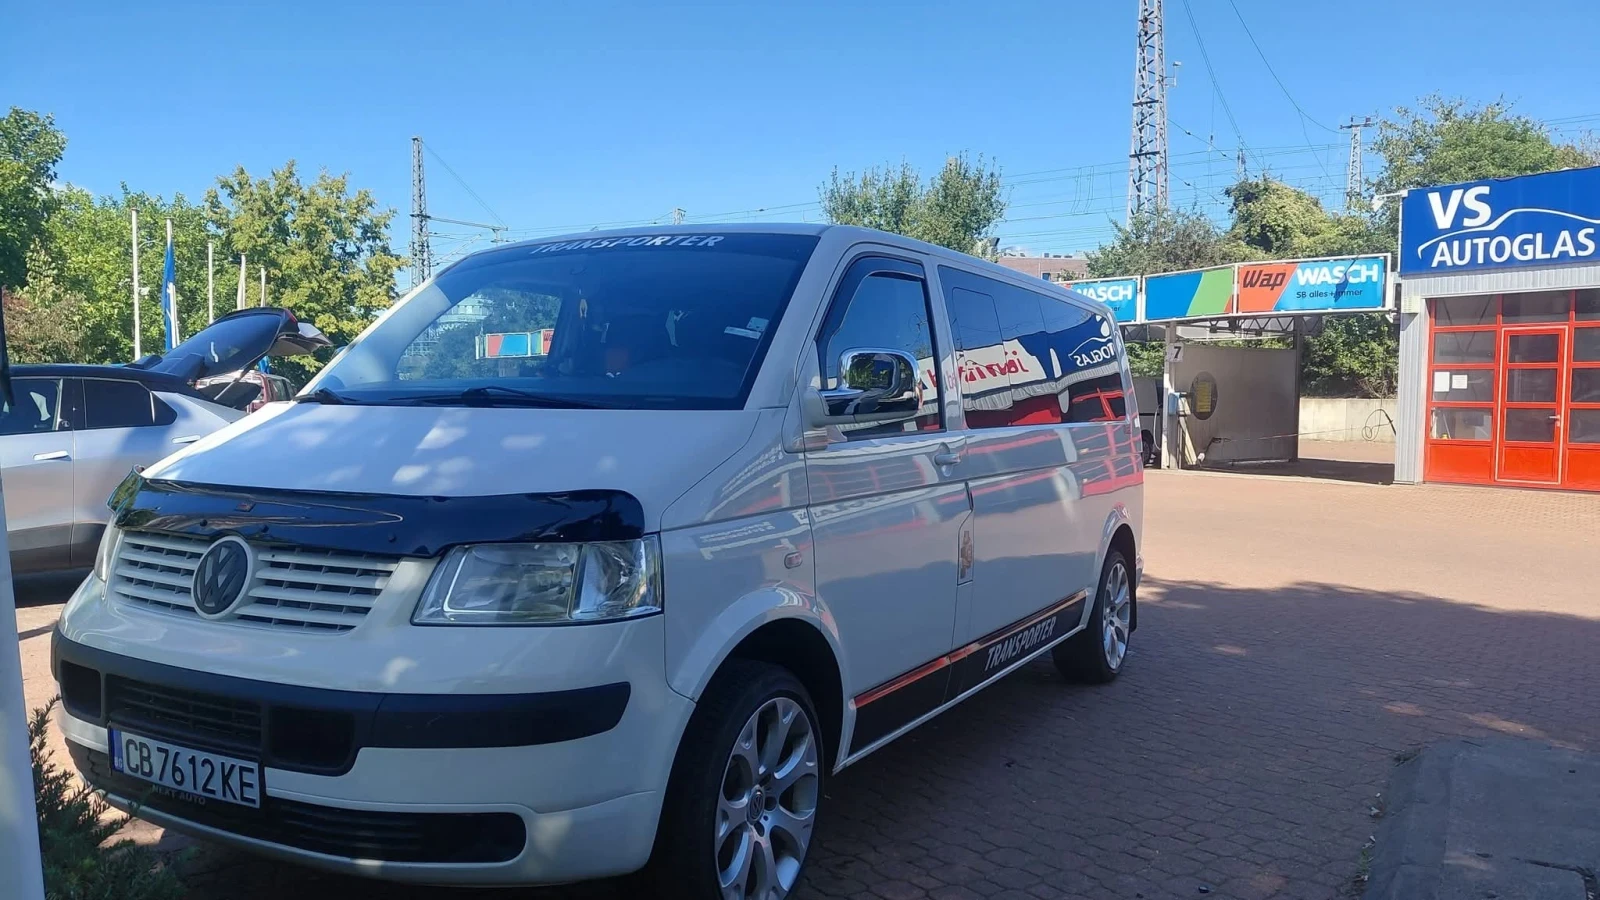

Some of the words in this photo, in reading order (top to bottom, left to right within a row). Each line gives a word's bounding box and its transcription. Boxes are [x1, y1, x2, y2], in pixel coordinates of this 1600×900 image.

[1427, 185, 1492, 230] VS
[530, 235, 725, 255] TRANSPORTER
[1431, 227, 1596, 268] AUTOGLAS
[1242, 268, 1287, 291] Wap
[1296, 263, 1379, 286] WASCH
[1296, 291, 1307, 299] SB
[1309, 290, 1328, 298] alles
[1173, 345, 1182, 359] 7
[984, 616, 1057, 672] TRANSPORTER
